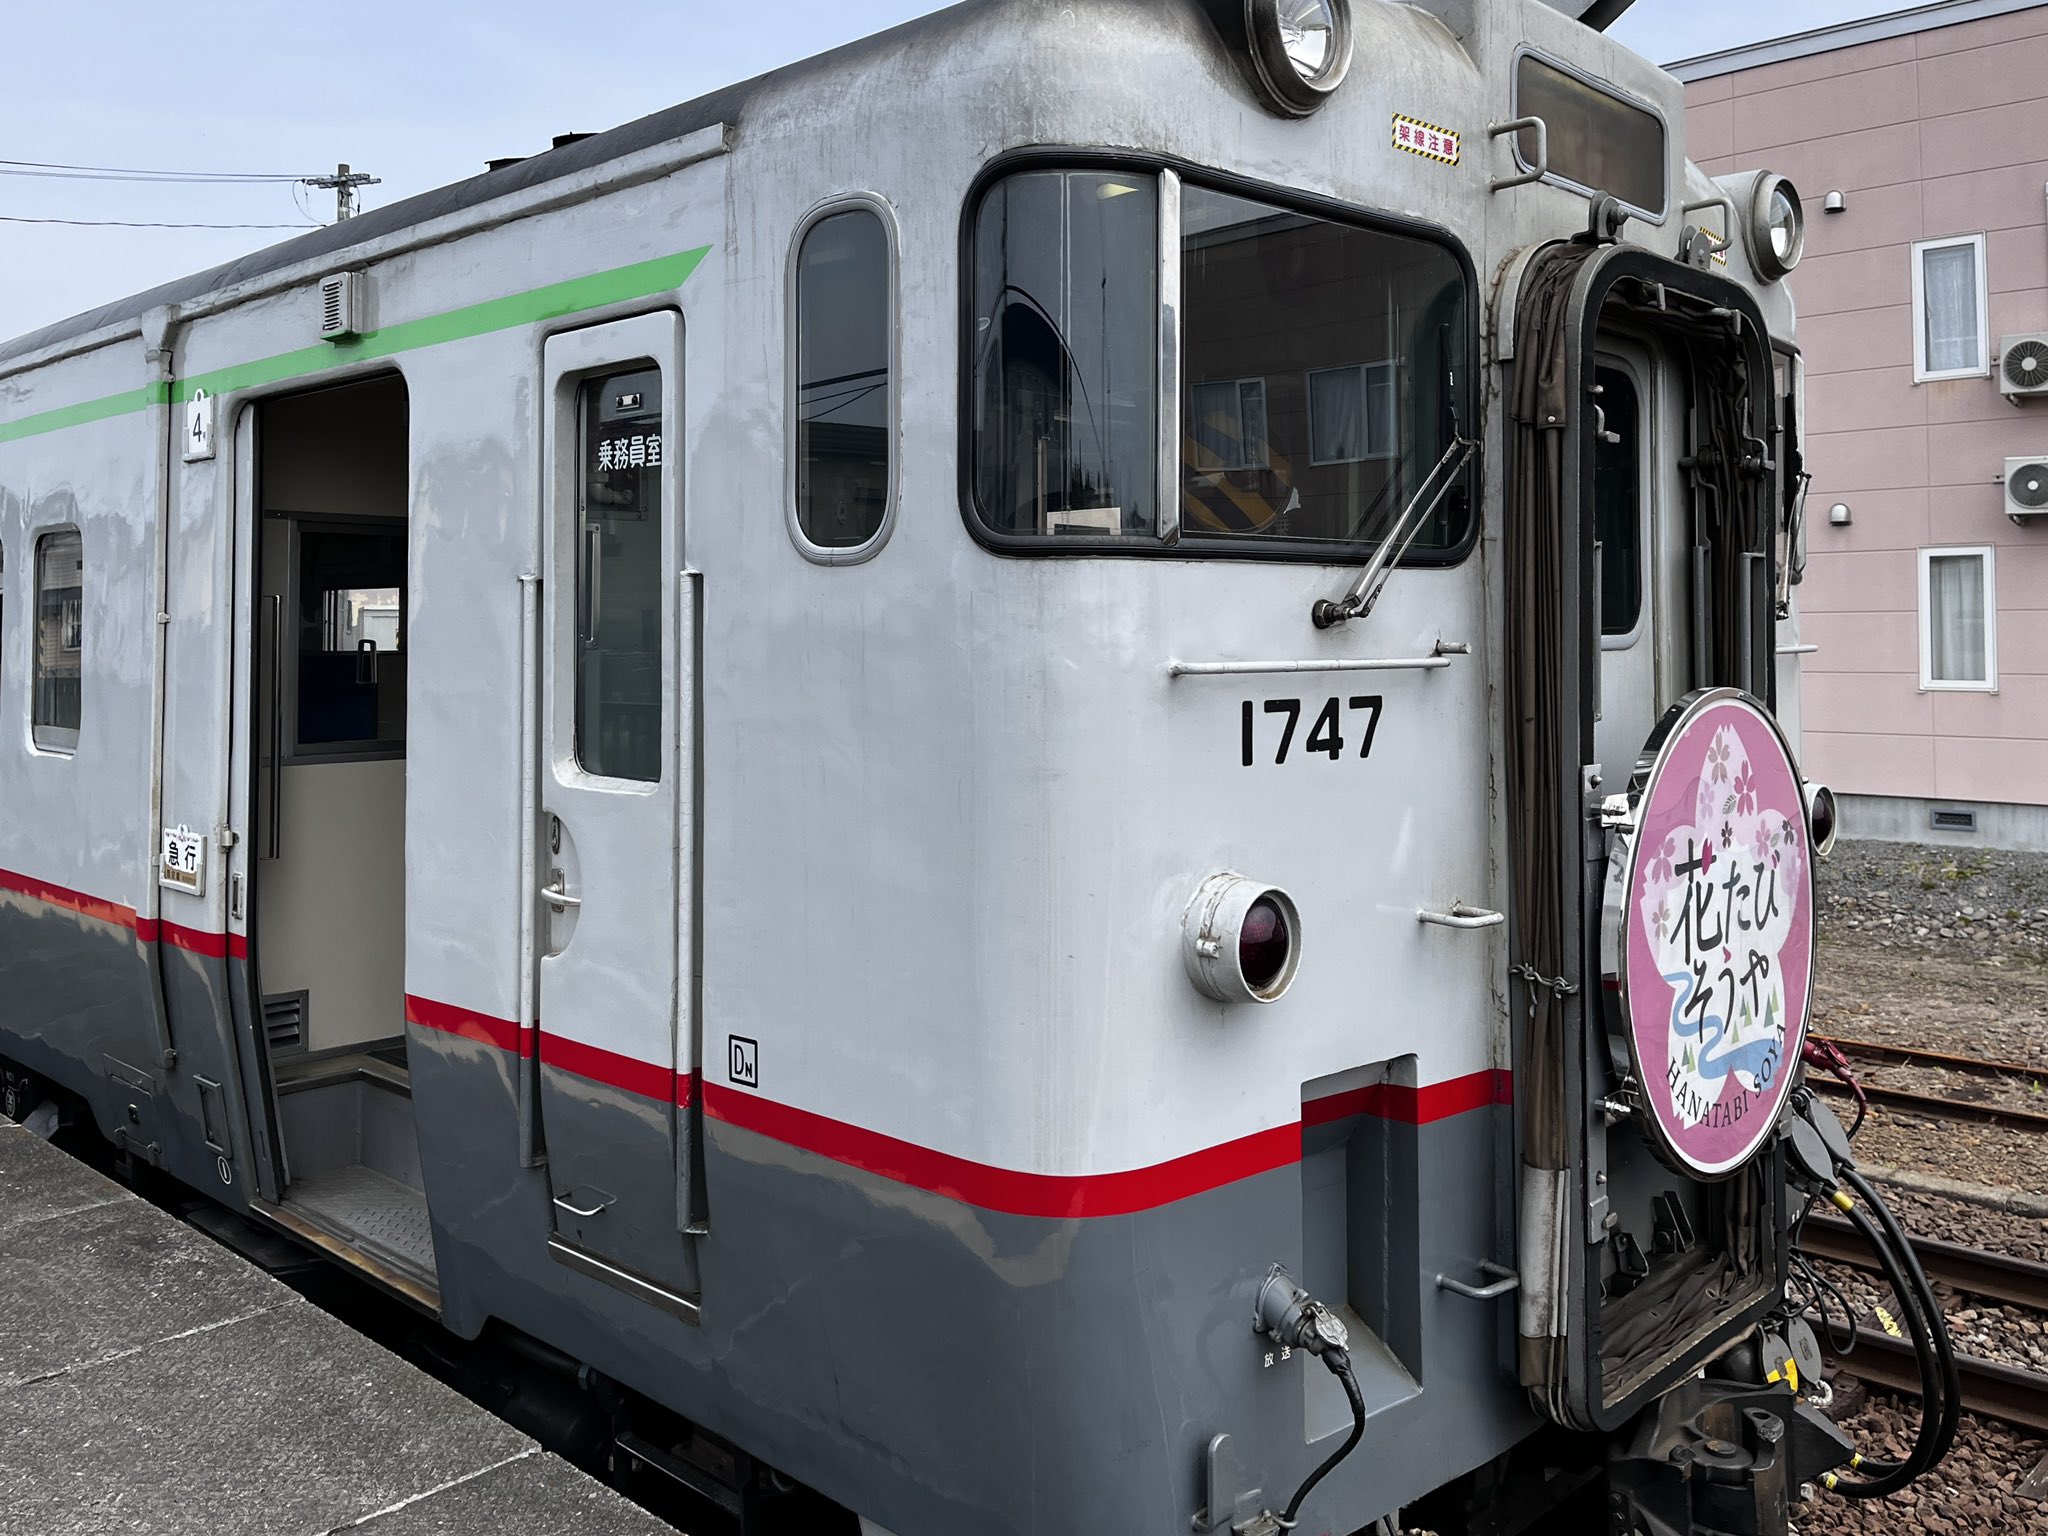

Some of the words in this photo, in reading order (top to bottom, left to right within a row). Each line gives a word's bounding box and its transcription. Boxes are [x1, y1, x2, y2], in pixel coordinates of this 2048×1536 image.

[1398, 124, 1454, 157] 架線注意
[598, 433, 662, 472] 乗務員室
[1242, 695, 1383, 767] 1747
[168, 840, 197, 872] 急行
[1669, 837, 1781, 966] 花たび
[1684, 948, 1770, 1045] そうや
[1665, 1056, 1749, 1129] HANATABI
[1753, 1023, 1787, 1100] SOYA
